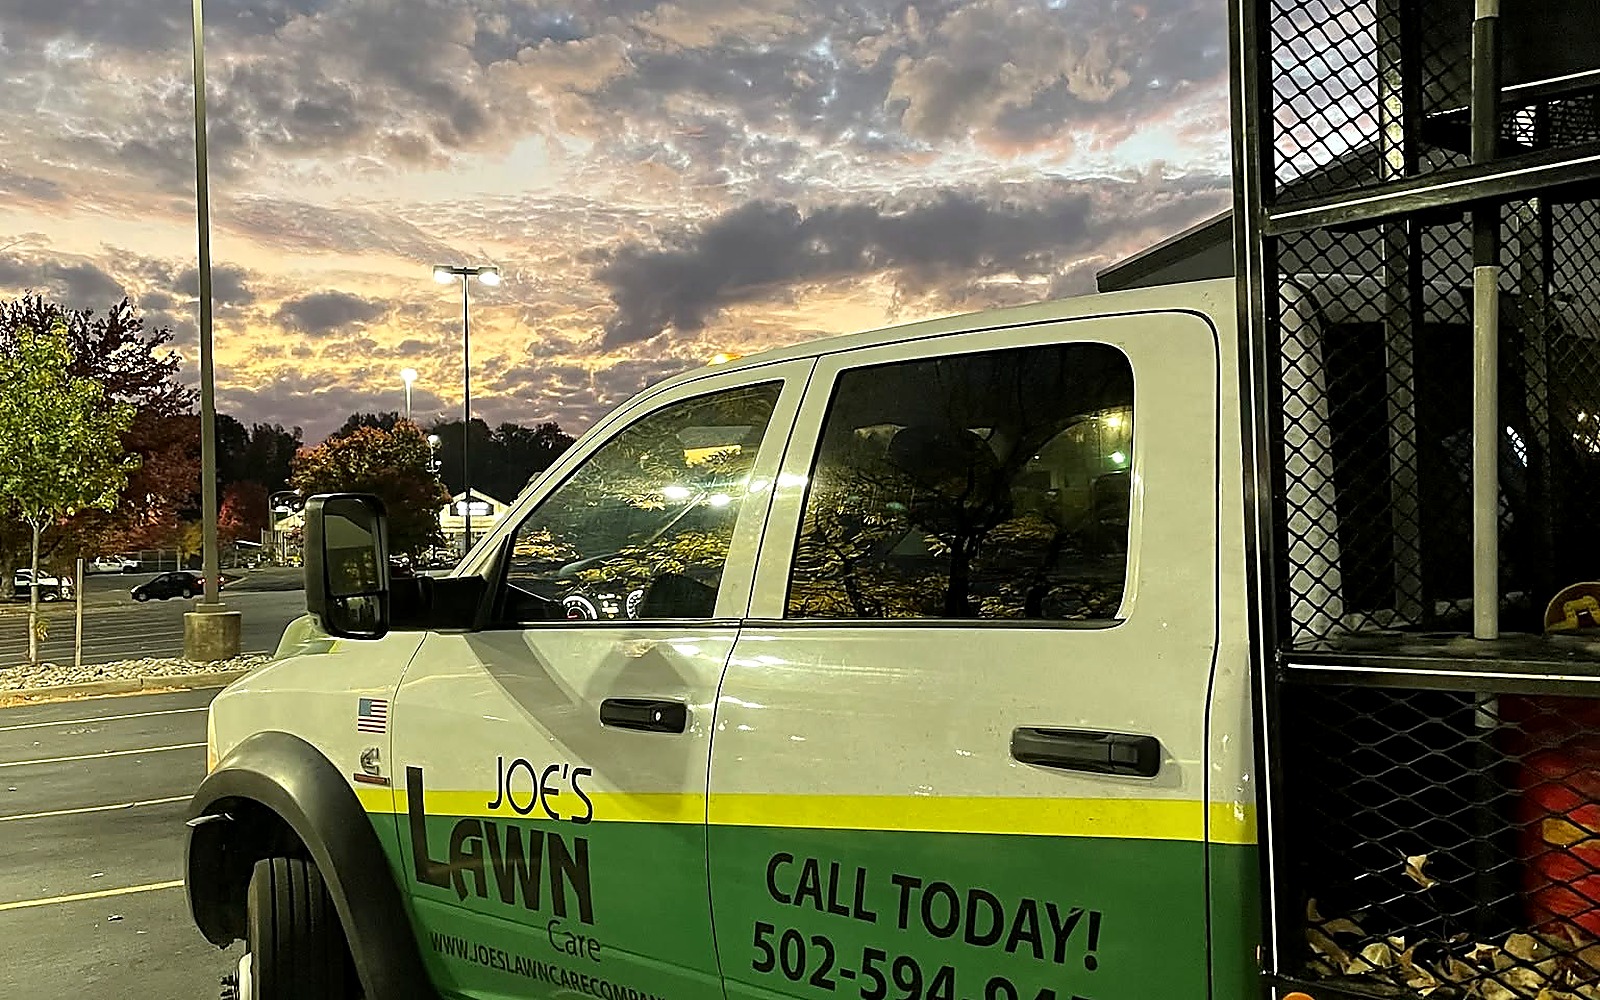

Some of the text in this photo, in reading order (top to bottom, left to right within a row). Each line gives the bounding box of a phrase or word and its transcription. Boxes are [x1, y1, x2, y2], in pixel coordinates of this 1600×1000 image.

[487, 756, 594, 825] JOE'S
[406, 766, 595, 926] LAWN
[547, 919, 601, 962] Care
[766, 852, 1102, 972] CALL TODAY!
